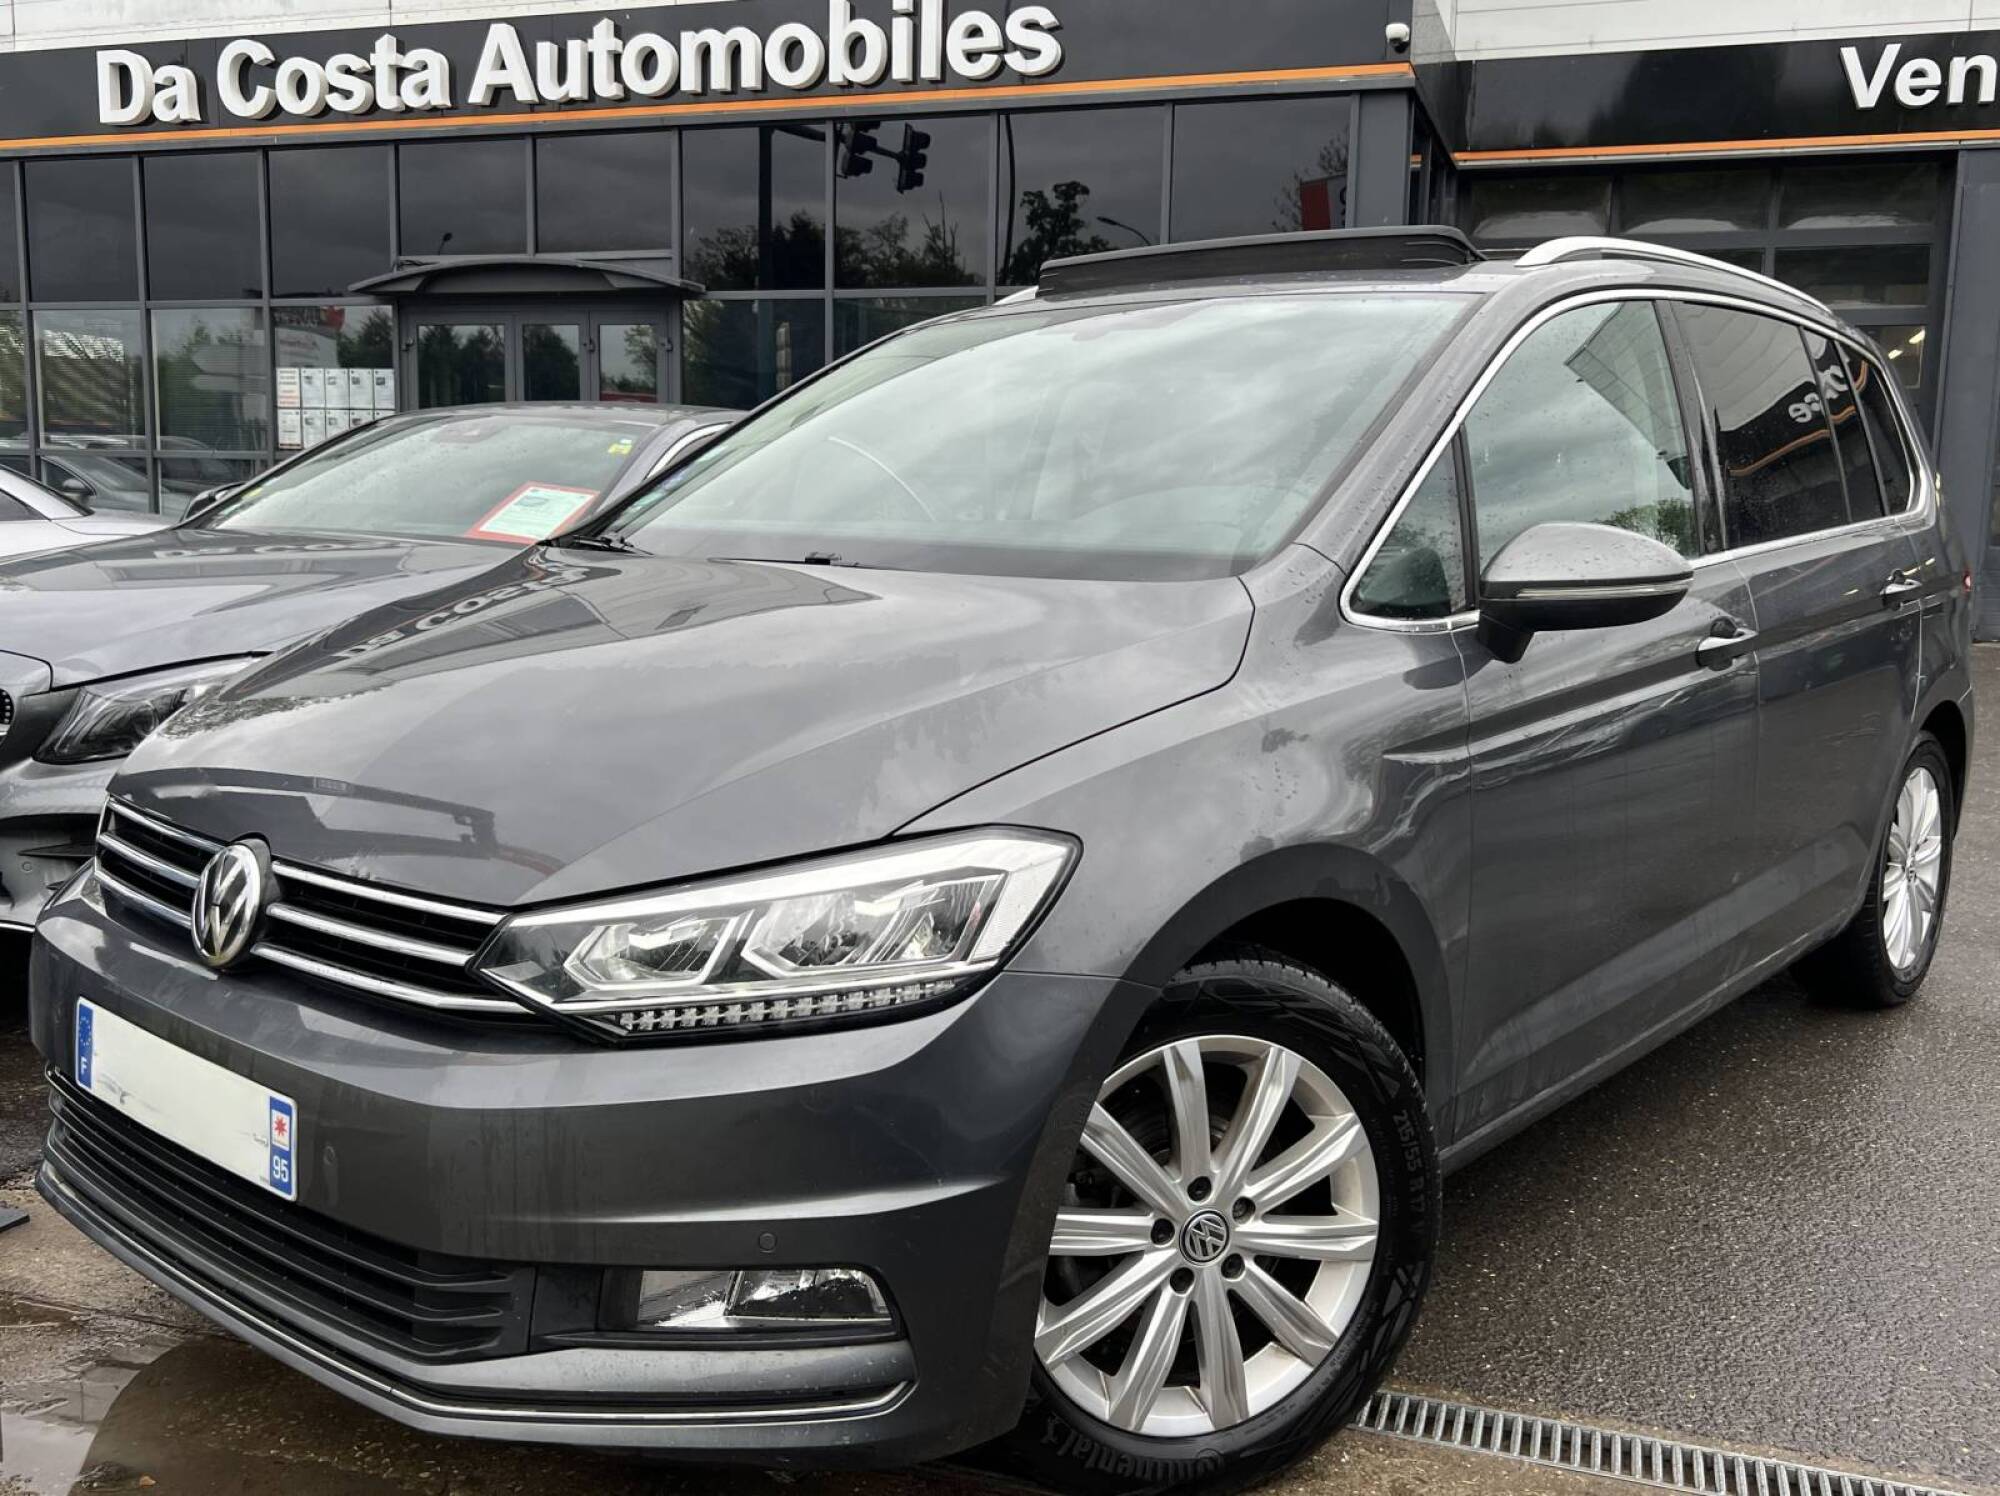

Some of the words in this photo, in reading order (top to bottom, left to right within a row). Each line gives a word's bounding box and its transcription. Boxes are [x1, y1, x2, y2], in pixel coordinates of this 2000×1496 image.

[96, 49, 201, 126] Da
[216, 33, 452, 120] Costa
[467, 0, 1062, 105] Automobiles
[1840, 43, 1998, 110] Ven
[80, 1056, 88, 1074] F
[272, 1154, 290, 1184] 95
[1393, 1109, 1423, 1172] 215/55
